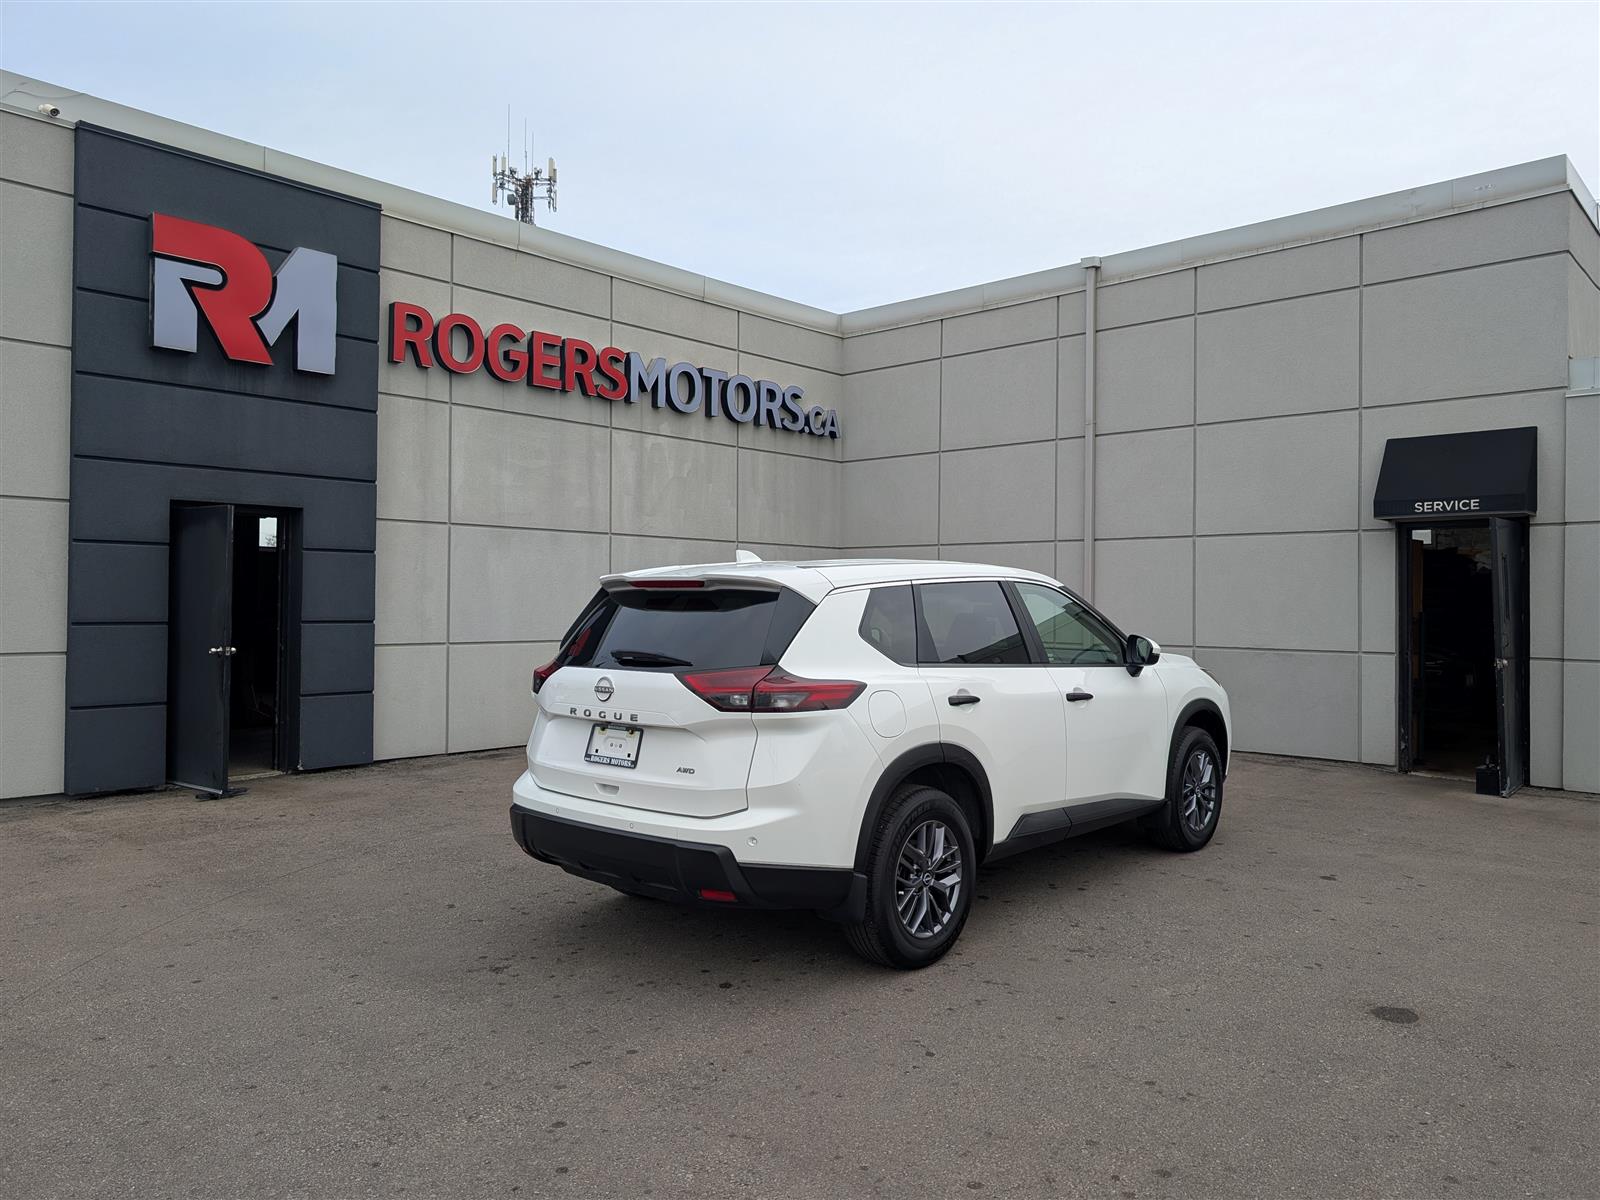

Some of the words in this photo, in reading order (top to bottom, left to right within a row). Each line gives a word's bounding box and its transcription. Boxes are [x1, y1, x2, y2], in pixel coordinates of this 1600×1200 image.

[389, 301, 840, 440] ROGERSMOTORS.CA
[1414, 499, 1480, 513] SERVICE
[569, 707, 639, 722] ROGUE
[591, 755, 610, 764] ROGERS
[610, 758, 631, 767] MOTORS
[676, 766, 695, 774] AWD
